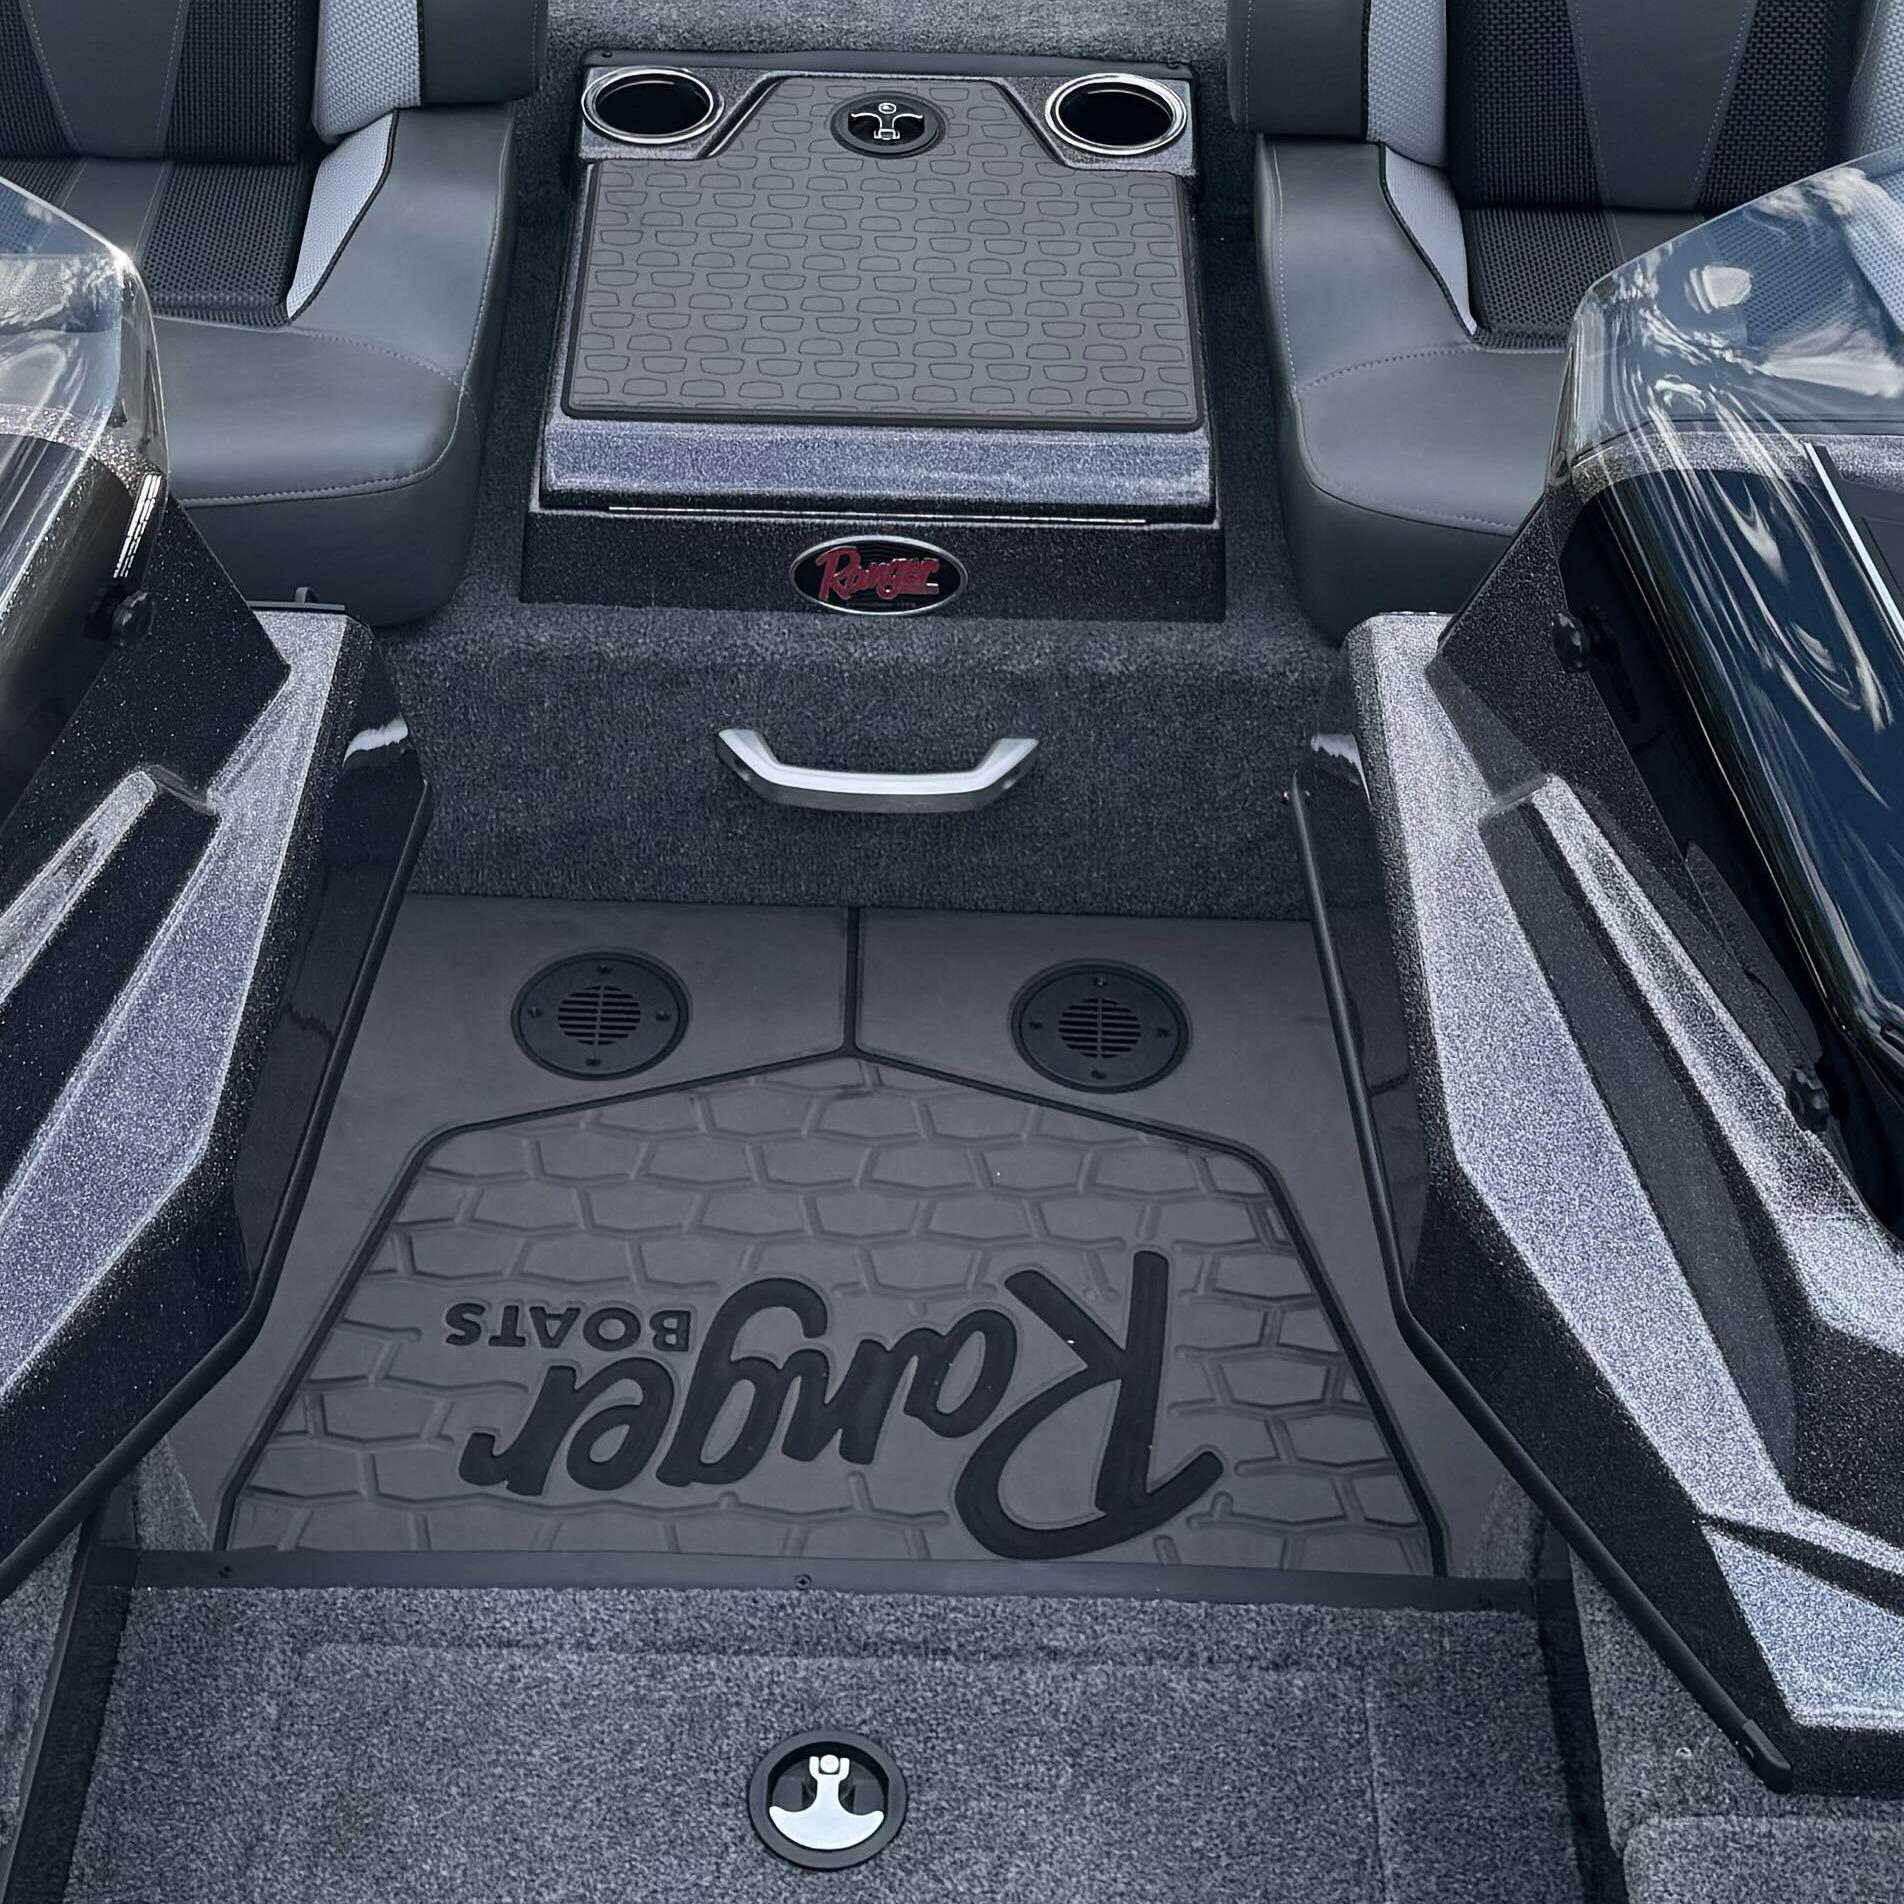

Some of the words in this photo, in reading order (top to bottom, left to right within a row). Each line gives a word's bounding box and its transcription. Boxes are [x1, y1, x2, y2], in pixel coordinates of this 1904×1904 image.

[816, 546, 940, 602] Ranger
[446, 1299, 692, 1354] BOATS
[457, 1249, 1224, 1560] Ranger
